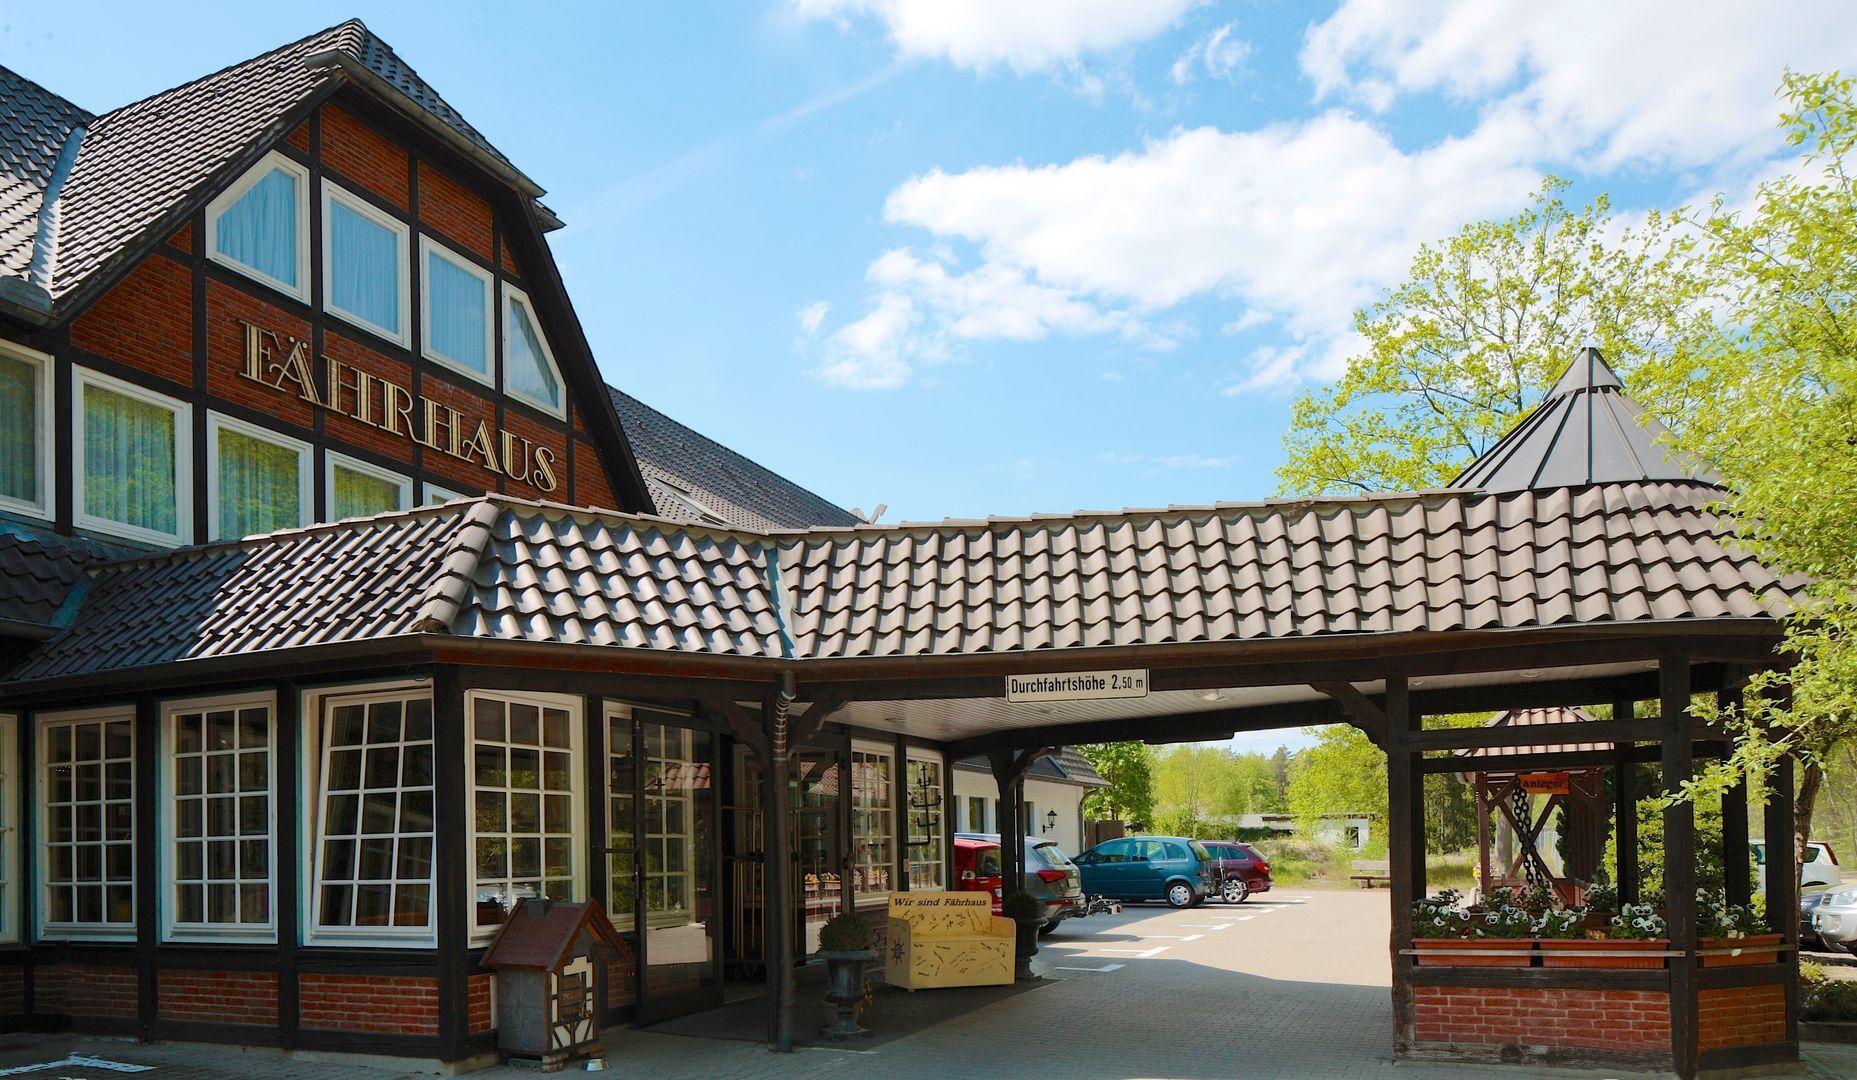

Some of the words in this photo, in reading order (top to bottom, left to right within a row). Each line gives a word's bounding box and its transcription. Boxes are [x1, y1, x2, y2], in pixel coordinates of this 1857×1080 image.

[238, 319, 557, 492] FÄHRHAUS
[1011, 675, 1105, 693] Durchfahrtshöhe
[1111, 674, 1132, 690] 2,50
[1136, 679, 1143, 688] m
[894, 898, 913, 906] Wir
[917, 898, 939, 906] sind
[944, 898, 986, 906] Fährhaus
